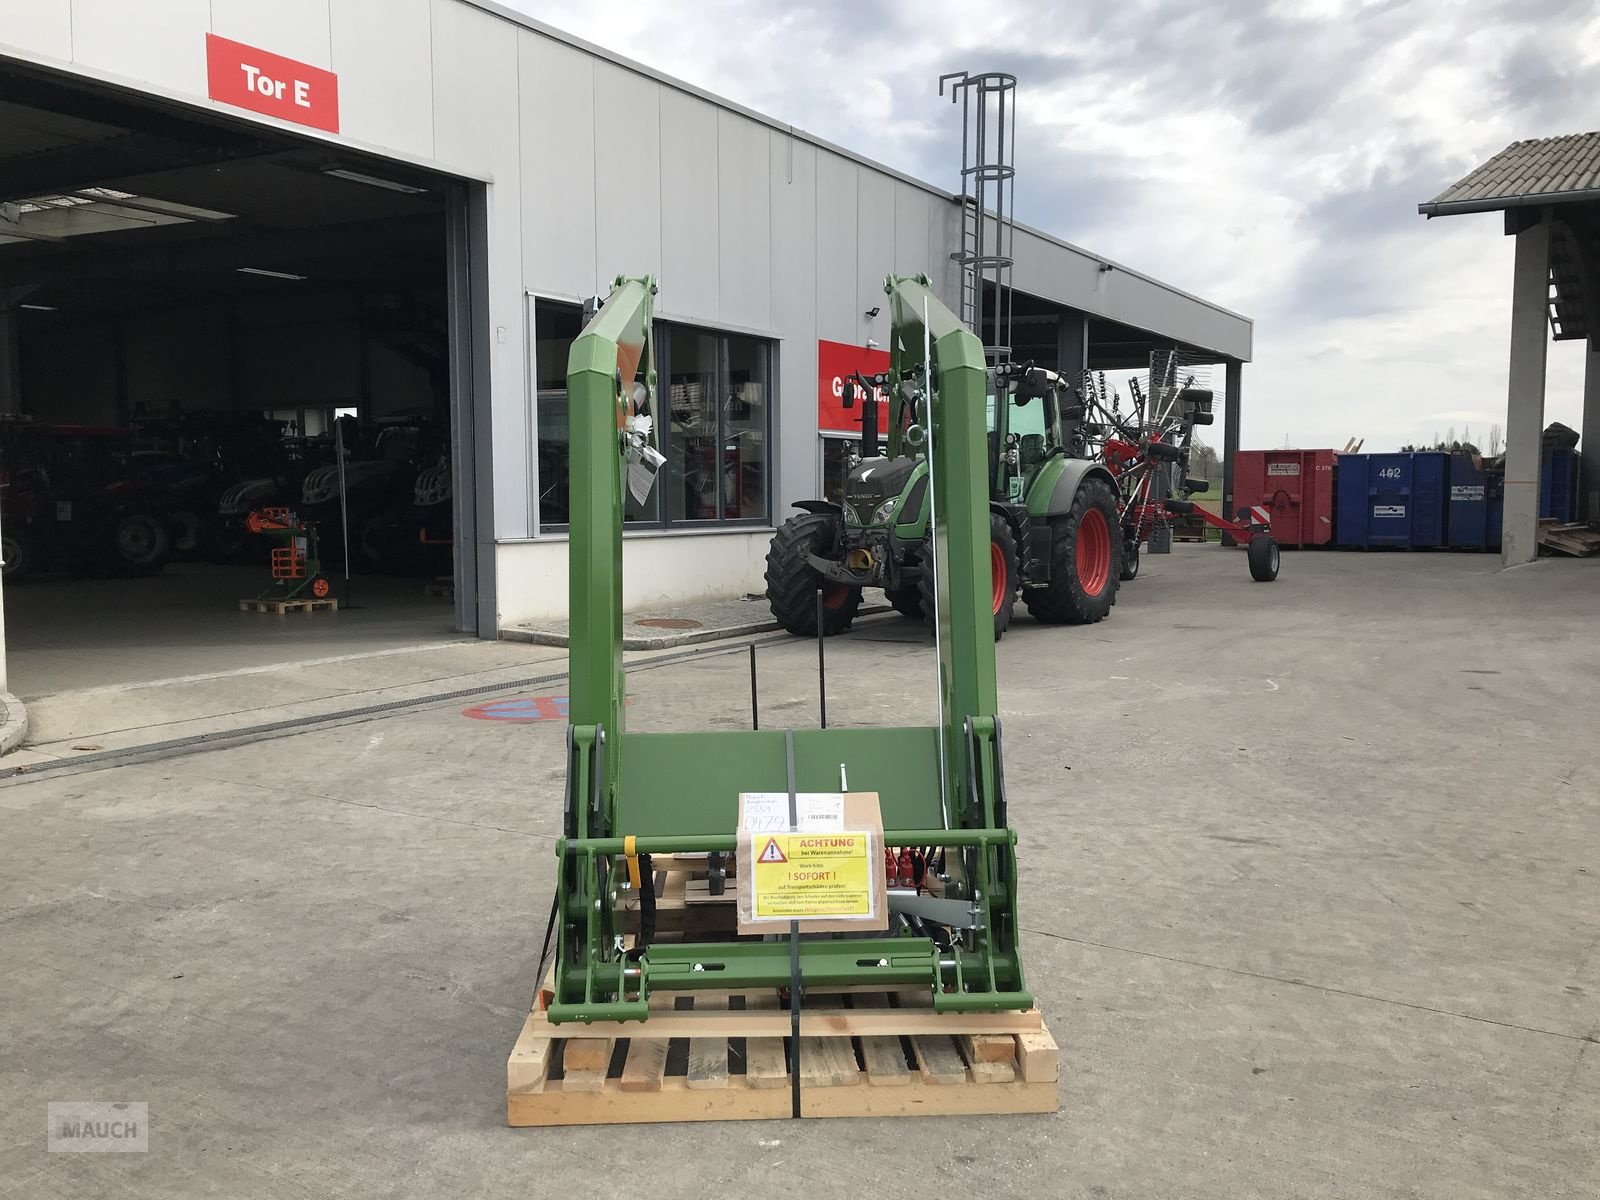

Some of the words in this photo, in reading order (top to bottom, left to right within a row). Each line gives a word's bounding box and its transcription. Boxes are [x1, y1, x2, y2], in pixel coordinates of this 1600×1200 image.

[240, 62, 286, 100] Tor
[294, 79, 311, 108] E
[799, 838, 855, 848] ACHTUNG
[793, 871, 831, 881] SOFORT
